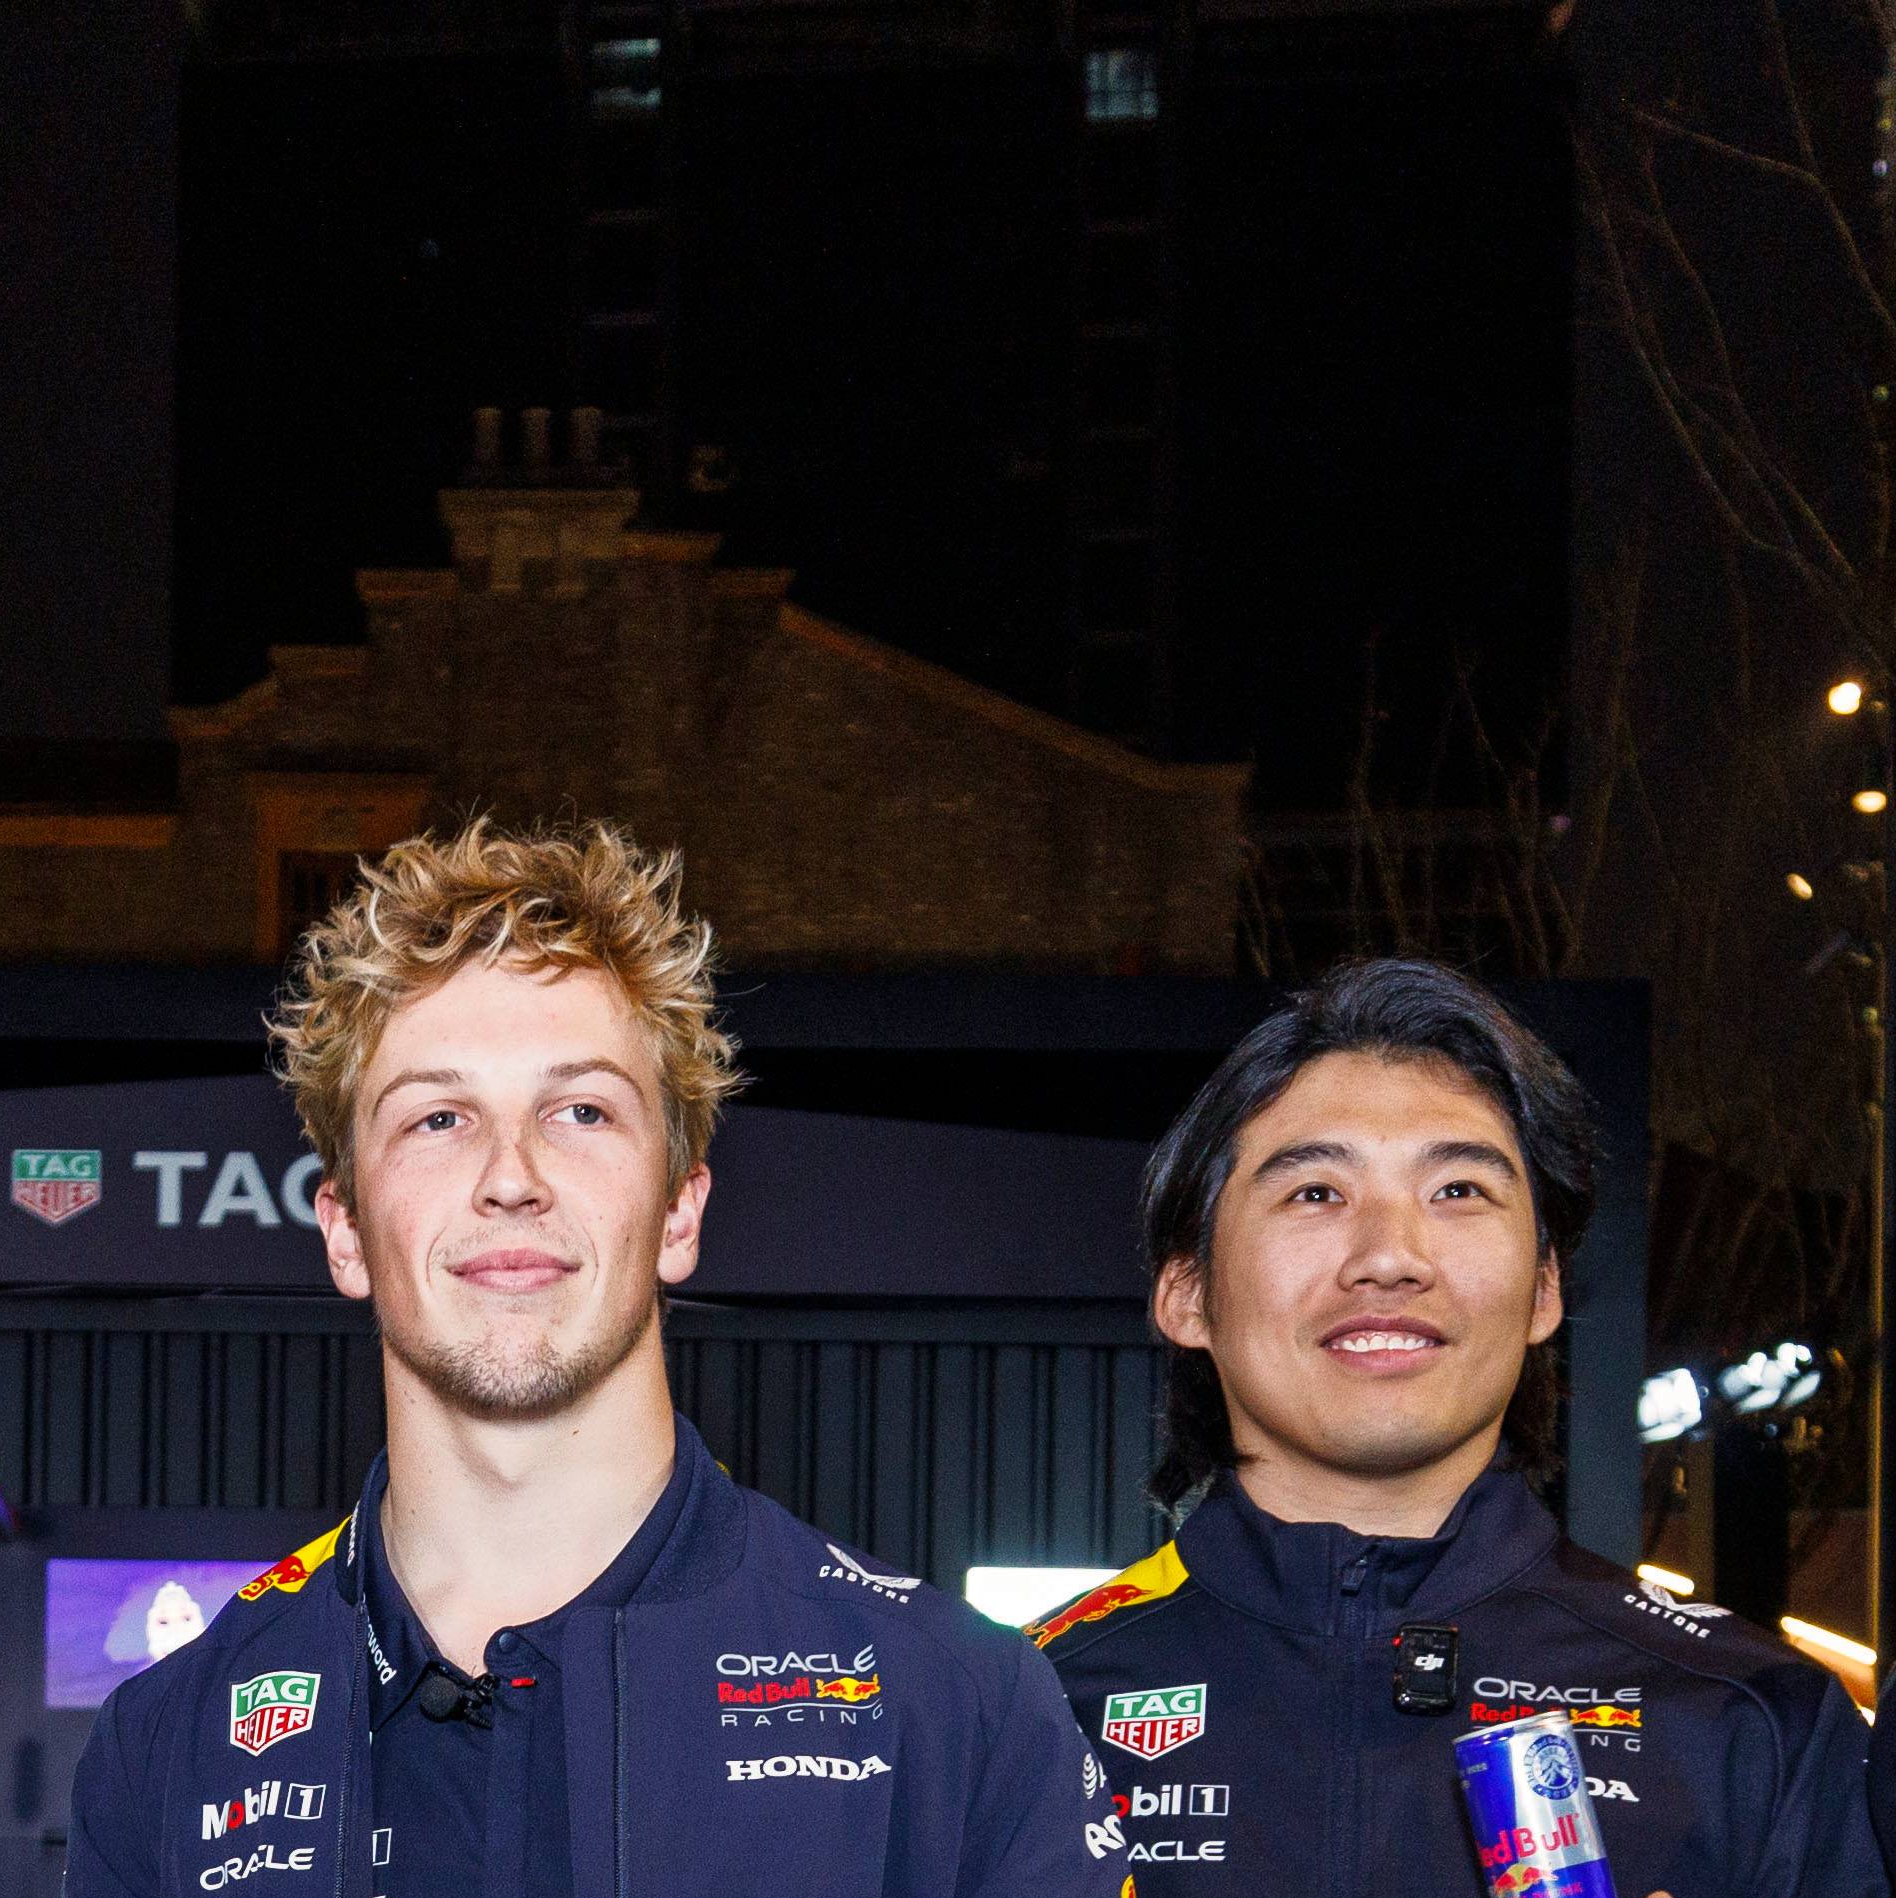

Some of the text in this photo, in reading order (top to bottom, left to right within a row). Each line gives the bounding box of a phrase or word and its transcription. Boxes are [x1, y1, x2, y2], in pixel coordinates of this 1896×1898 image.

[21, 1154, 91, 1177] TAG
[819, 1565, 910, 1604] CASTORE
[1624, 1594, 1711, 1638] CASTORE
[716, 1644, 877, 1677] ORACLE
[240, 1676, 310, 1712] TAG
[717, 1677, 811, 1704] Red Bull
[1115, 1691, 1197, 1717] TAG
[1473, 1676, 1643, 1703] ORACLE
[721, 1704, 884, 1727] RACING
[1470, 1702, 1517, 1722] Red
[235, 1708, 310, 1752] HEUER
[1109, 1718, 1198, 1755] HEUER
[725, 1755, 892, 1781] HONDA
[201, 1780, 282, 1840] Mobil
[1111, 1784, 1182, 1818] obil
[1127, 1840, 1226, 1862] ACLE
